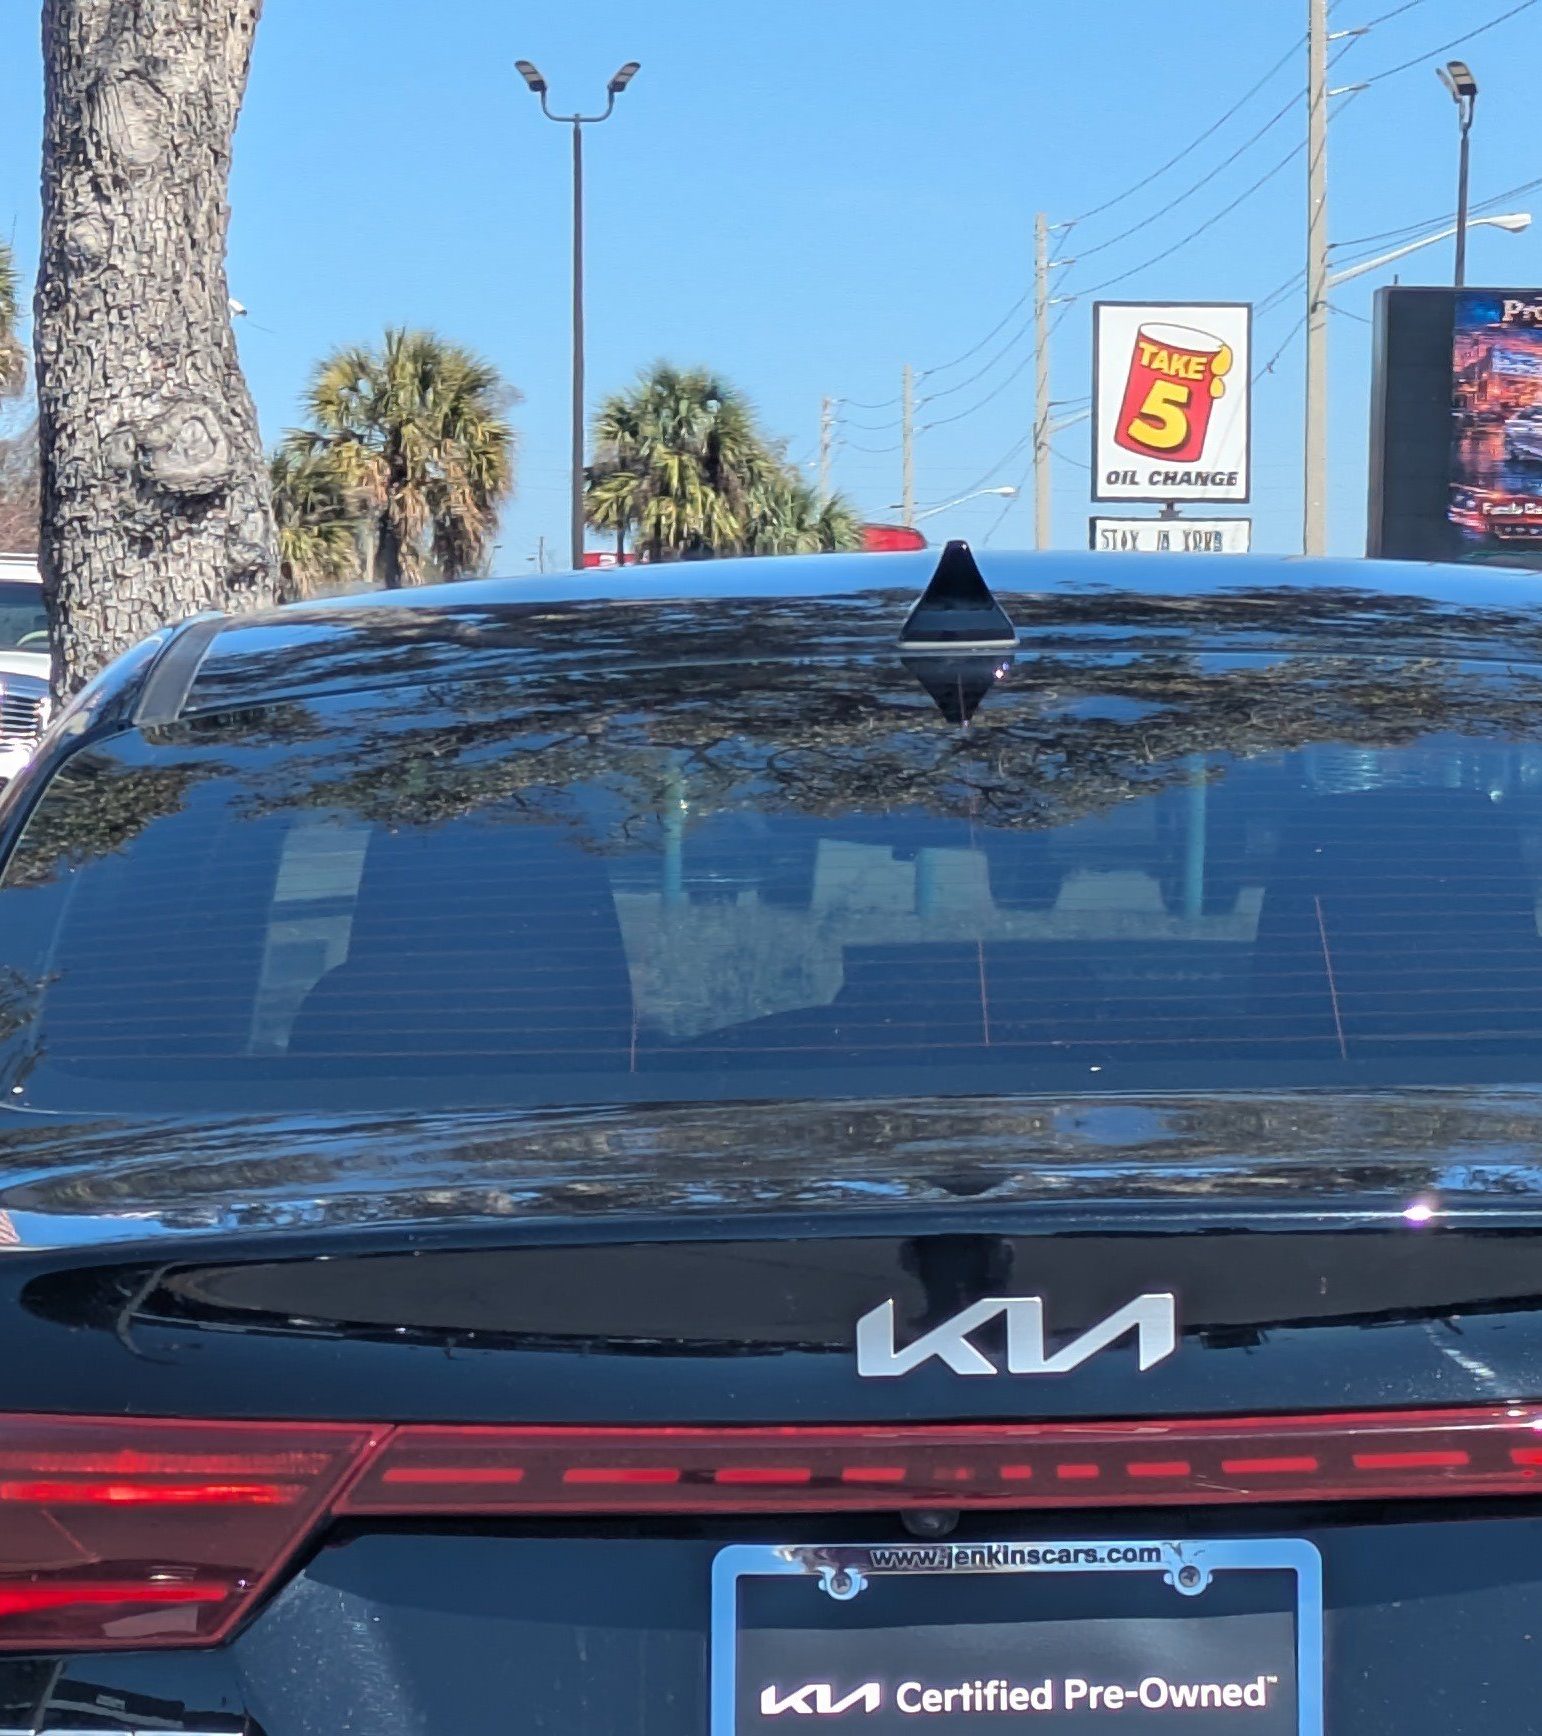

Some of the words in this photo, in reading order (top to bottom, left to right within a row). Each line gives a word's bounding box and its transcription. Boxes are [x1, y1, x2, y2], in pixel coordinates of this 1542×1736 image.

[1138, 341, 1209, 381] TAKE
[1127, 379, 1189, 449] 5
[1105, 469, 1140, 487] OIL
[1149, 469, 1239, 488] CHANGE
[857, 1293, 1175, 1377] KIA
[869, 1543, 1162, 1572] www.jenkinscars.com
[760, 1682, 882, 1716] KIA
[897, 1679, 1053, 1714] Certified
